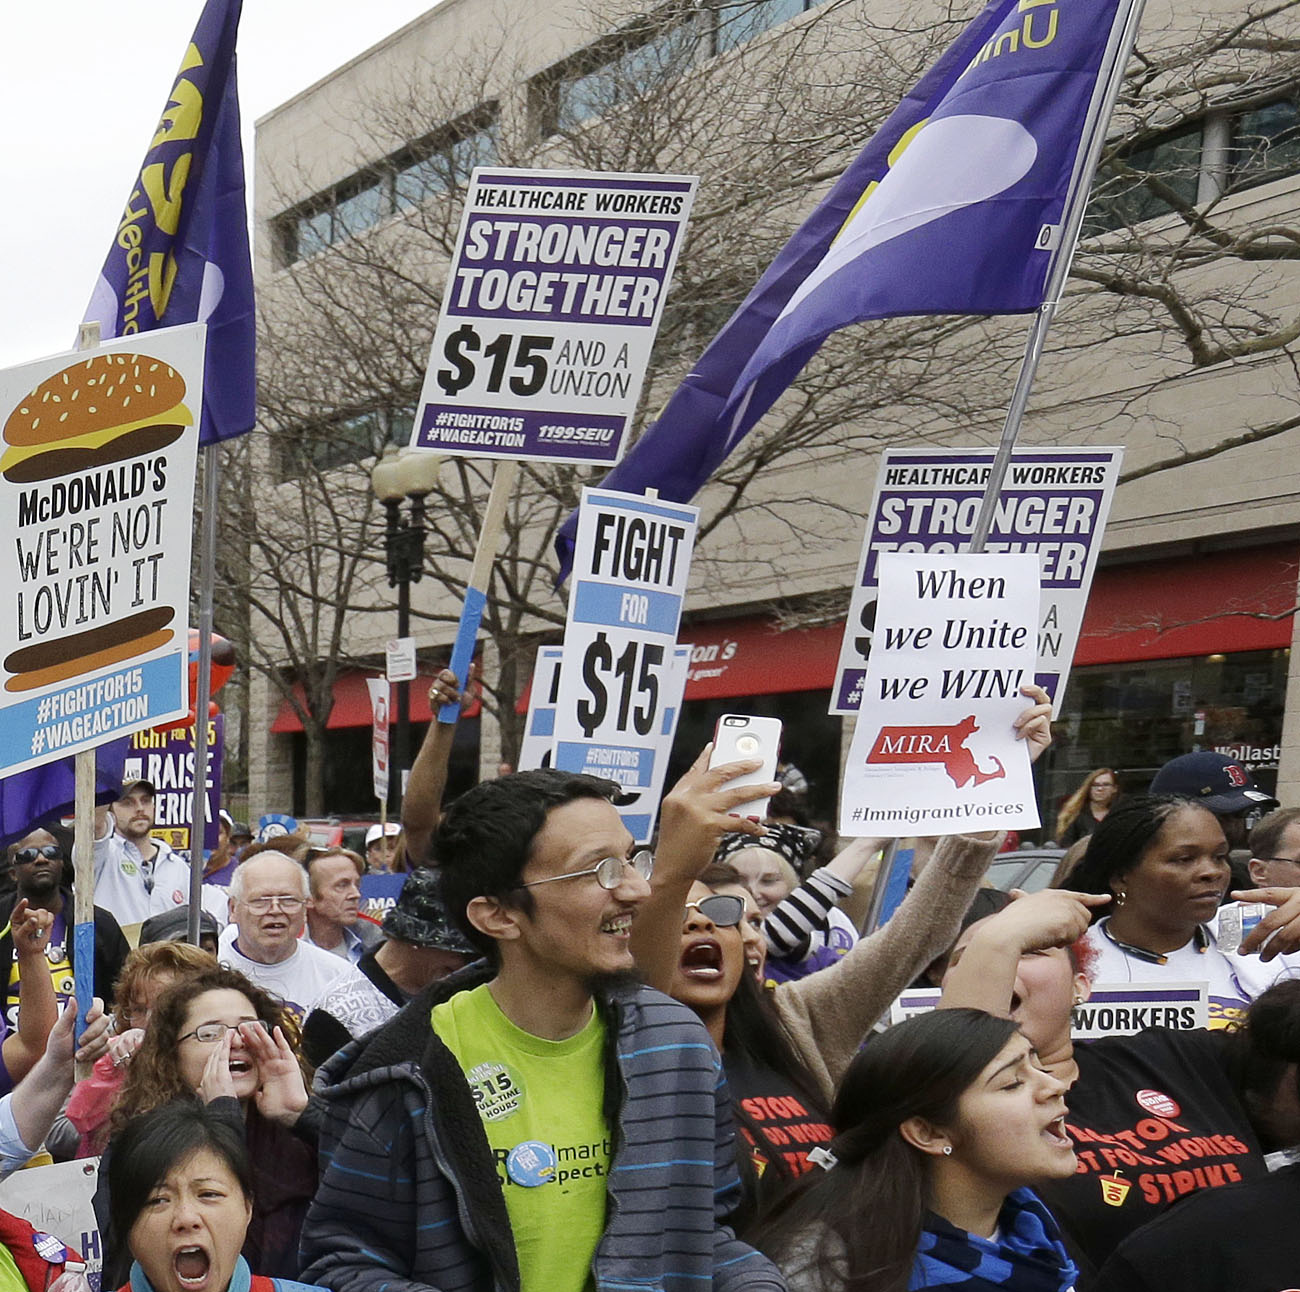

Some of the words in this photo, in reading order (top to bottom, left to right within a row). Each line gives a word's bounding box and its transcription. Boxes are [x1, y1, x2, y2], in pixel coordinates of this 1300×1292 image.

[474, 188, 588, 212] HEALTHCARE
[595, 193, 684, 215] WORKERS
[465, 219, 671, 269] STRONGER
[456, 267, 660, 319] TOGETHER
[436, 324, 555, 397] $15
[555, 339, 606, 368] AND
[613, 342, 629, 370] A
[550, 371, 632, 400] UNION
[435, 411, 524, 432] #FIGHTFOR15
[538, 425, 615, 441] 1199SEIU
[427, 427, 526, 448] #WAGEACTION
[18, 455, 168, 528] McDONALD'S
[885, 467, 992, 486] HEALTHCAR
[1011, 466, 1106, 485] WORKERS
[877, 496, 1096, 535] STRONGER
[16, 518, 101, 583] WE'RE
[112, 499, 168, 559] NOT
[590, 512, 687, 587] FIGHT
[17, 569, 119, 642] LOVIN'
[131, 553, 165, 608] IT
[915, 569, 1006, 600] When
[619, 591, 648, 627] FOR
[1042, 604, 1058, 629] A
[884, 625, 932, 651] we
[942, 619, 1028, 650] Unite
[36, 667, 144, 725] #FIGHTFOR15
[576, 632, 664, 738] $15
[879, 677, 929, 701] we
[940, 669, 1024, 700] WIN!
[31, 694, 149, 756] #WAGEACTION
[879, 733, 952, 755] MIRA
[1213, 744, 1281, 761] Wollast
[851, 803, 1024, 824] #ImmigrantVoices
[1074, 1006, 1196, 1030] WORKERS
[478, 1087, 522, 1111] ULL-TIME
[485, 1099, 518, 1118] HOURS
[741, 1095, 809, 1121] STON
